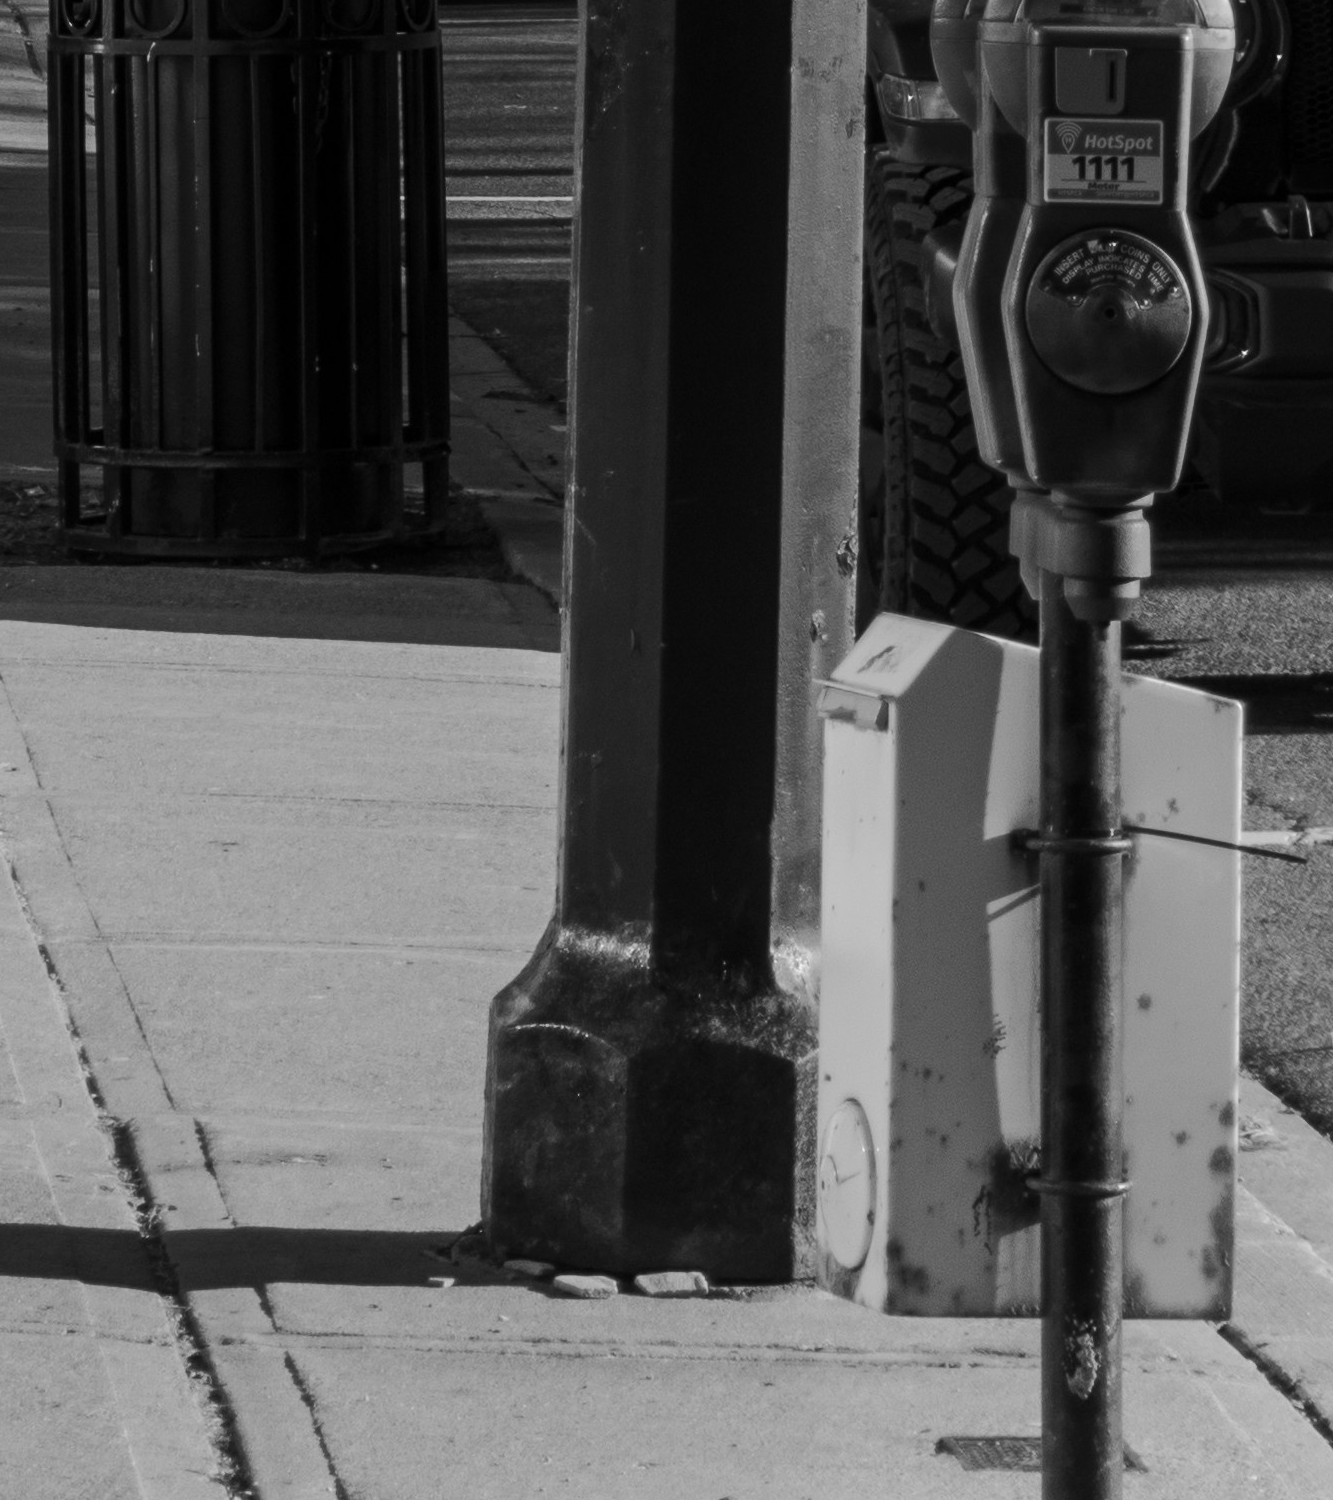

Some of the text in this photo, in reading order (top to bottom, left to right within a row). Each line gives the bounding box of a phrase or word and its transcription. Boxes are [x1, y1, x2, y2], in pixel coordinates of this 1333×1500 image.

[1085, 133, 1154, 153] HotSpot
[1071, 156, 1135, 181] 1111
[1087, 182, 1121, 190] Meter
[1053, 248, 1085, 276] INSERT
[1120, 244, 1151, 264] COINS
[1151, 261, 1172, 284] ONLY
[1061, 258, 1095, 285] DISPLAY
[1098, 253, 1146, 273] INDICATES
[1147, 271, 1165, 293] TIME
[1085, 263, 1143, 281] PURCHASED
